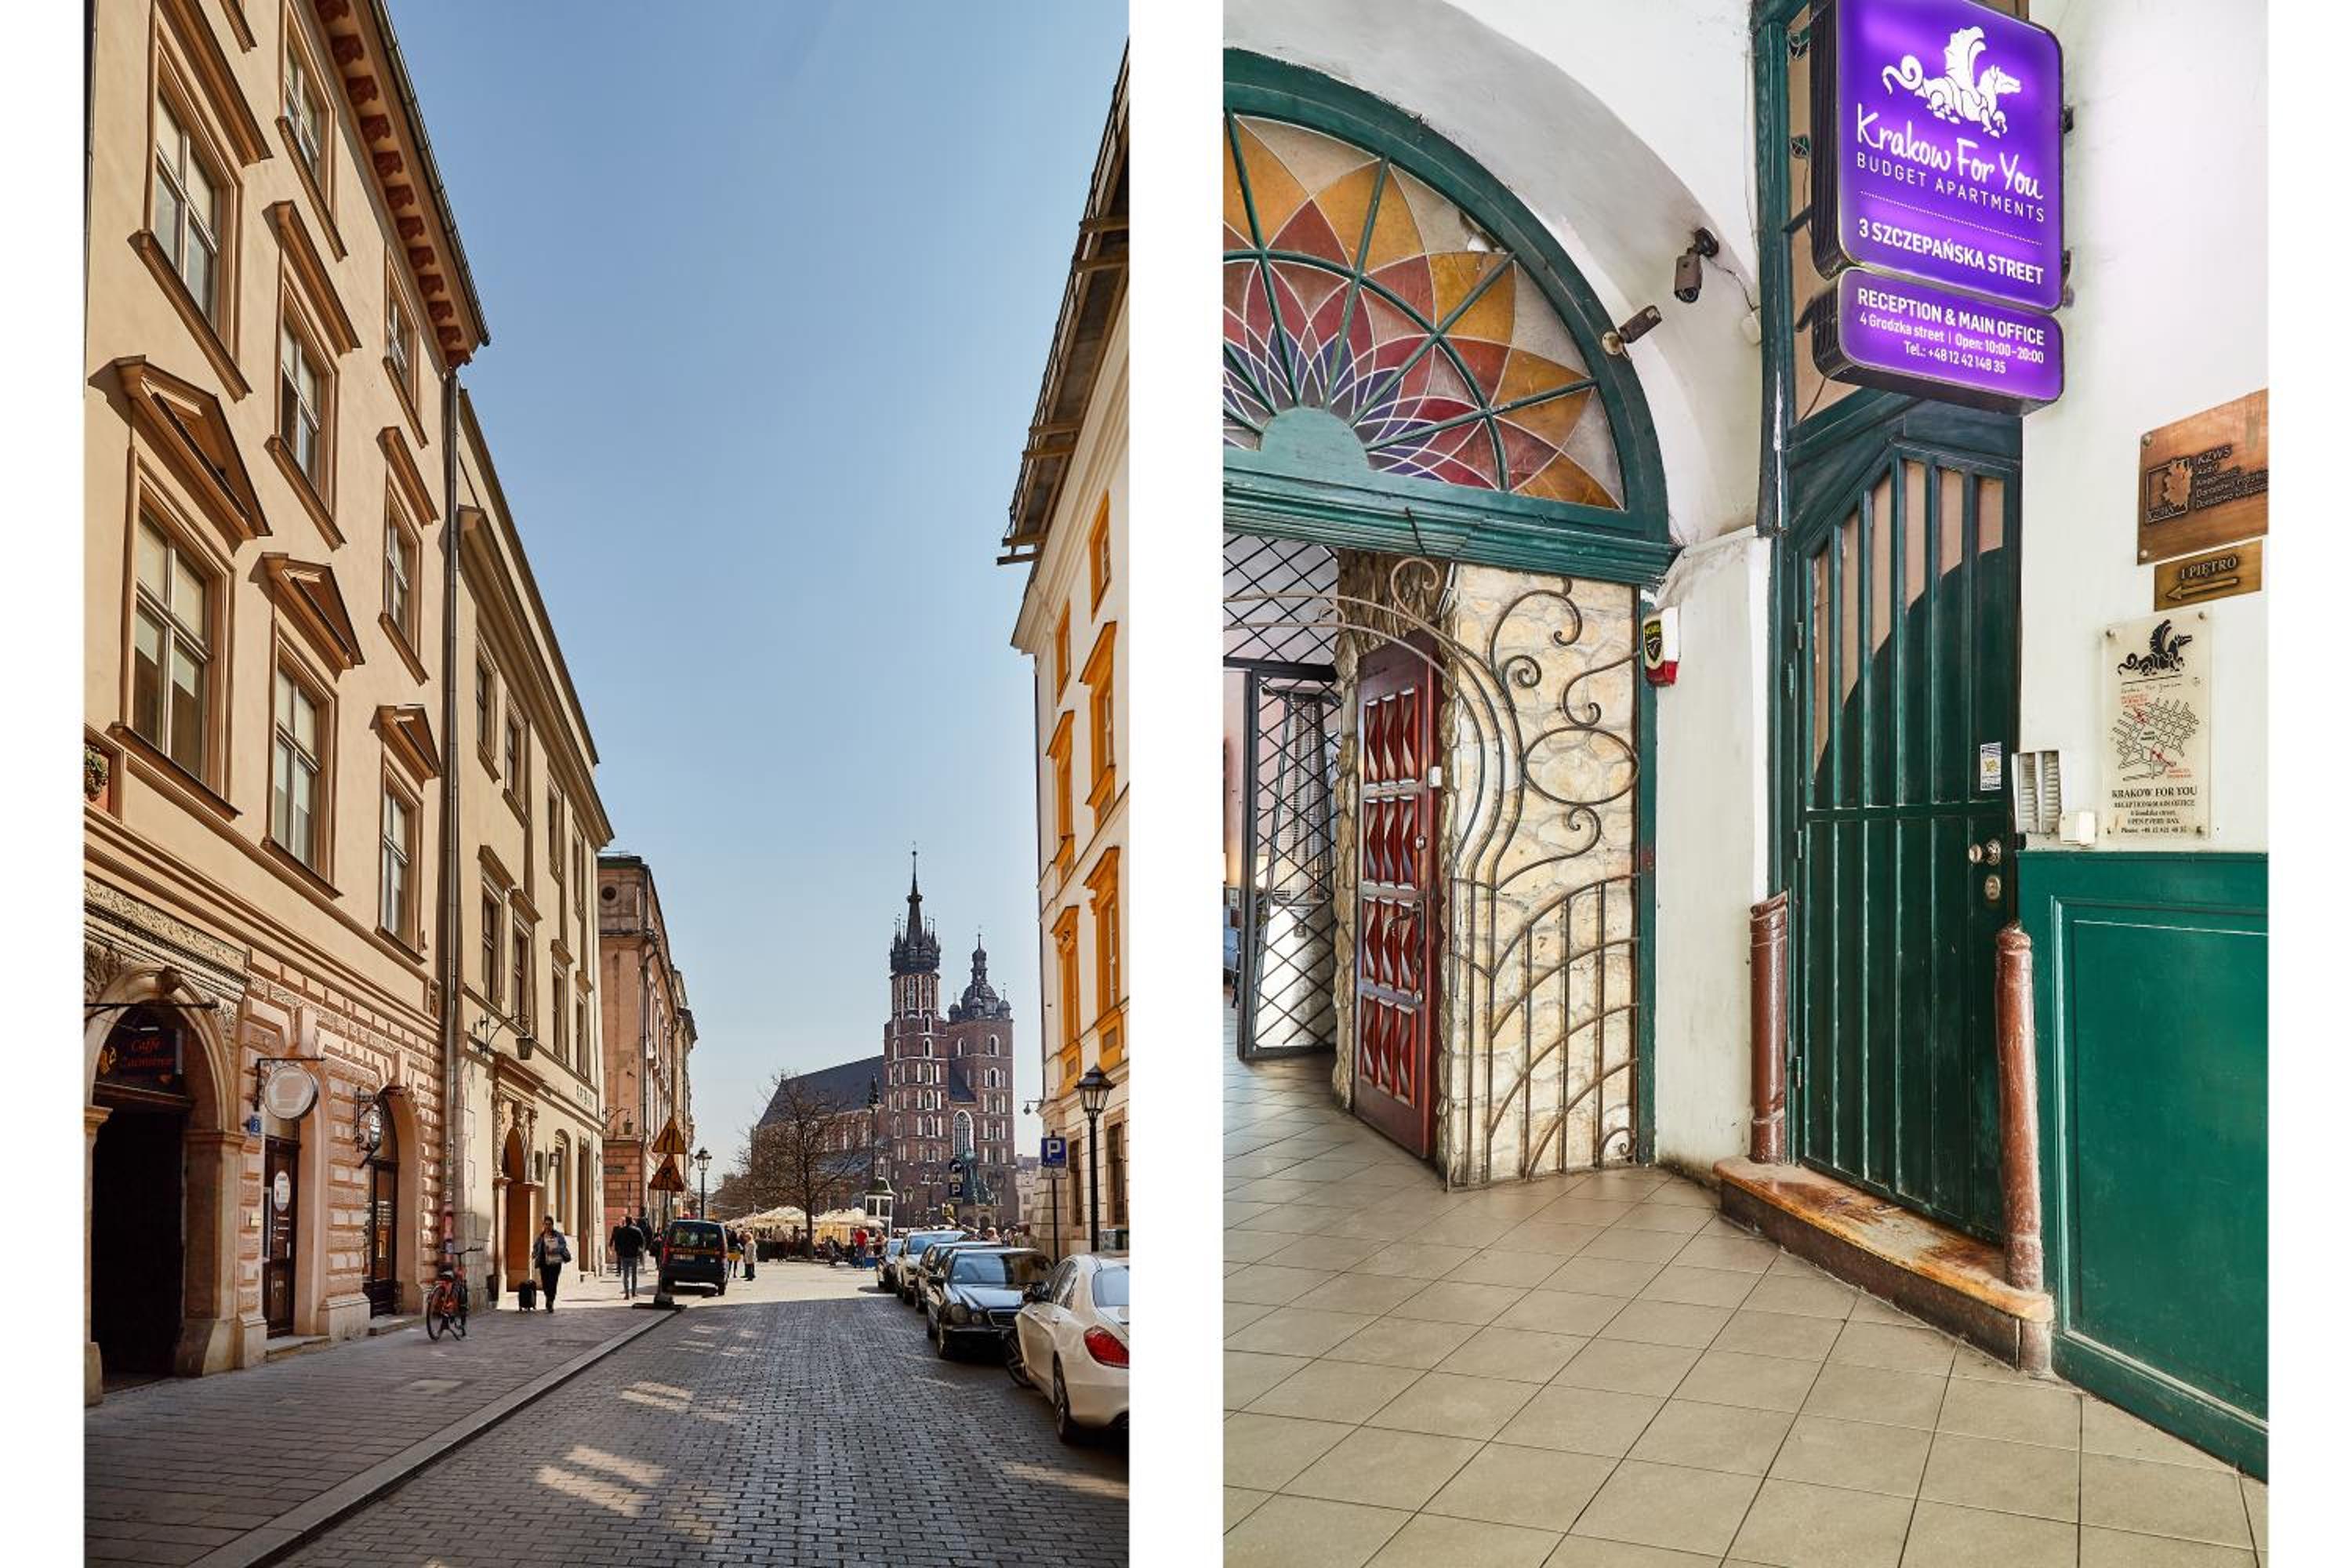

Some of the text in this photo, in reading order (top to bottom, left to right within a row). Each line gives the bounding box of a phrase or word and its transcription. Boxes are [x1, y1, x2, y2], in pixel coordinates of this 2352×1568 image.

[1857, 103, 2044, 200] Krakow For You
[1857, 151, 2045, 223] BUDGET APARTMENTS
[1859, 218, 2044, 285] 3 SZCZEPAŃSKA STREET
[1858, 288, 2045, 346] RECEPTION & MAIN OFFICE
[1860, 312, 1867, 325] 4
[1869, 314, 1912, 336] Grodzka
[1914, 324, 1945, 343] street
[1955, 333, 1983, 350] Open:
[1928, 347, 1947, 361] +48
[1949, 350, 1959, 365] 12
[1994, 360, 2006, 375] 35
[2111, 786, 2198, 798] KRAKOW FOR YOU
[1047, 1140, 1061, 1156] P
